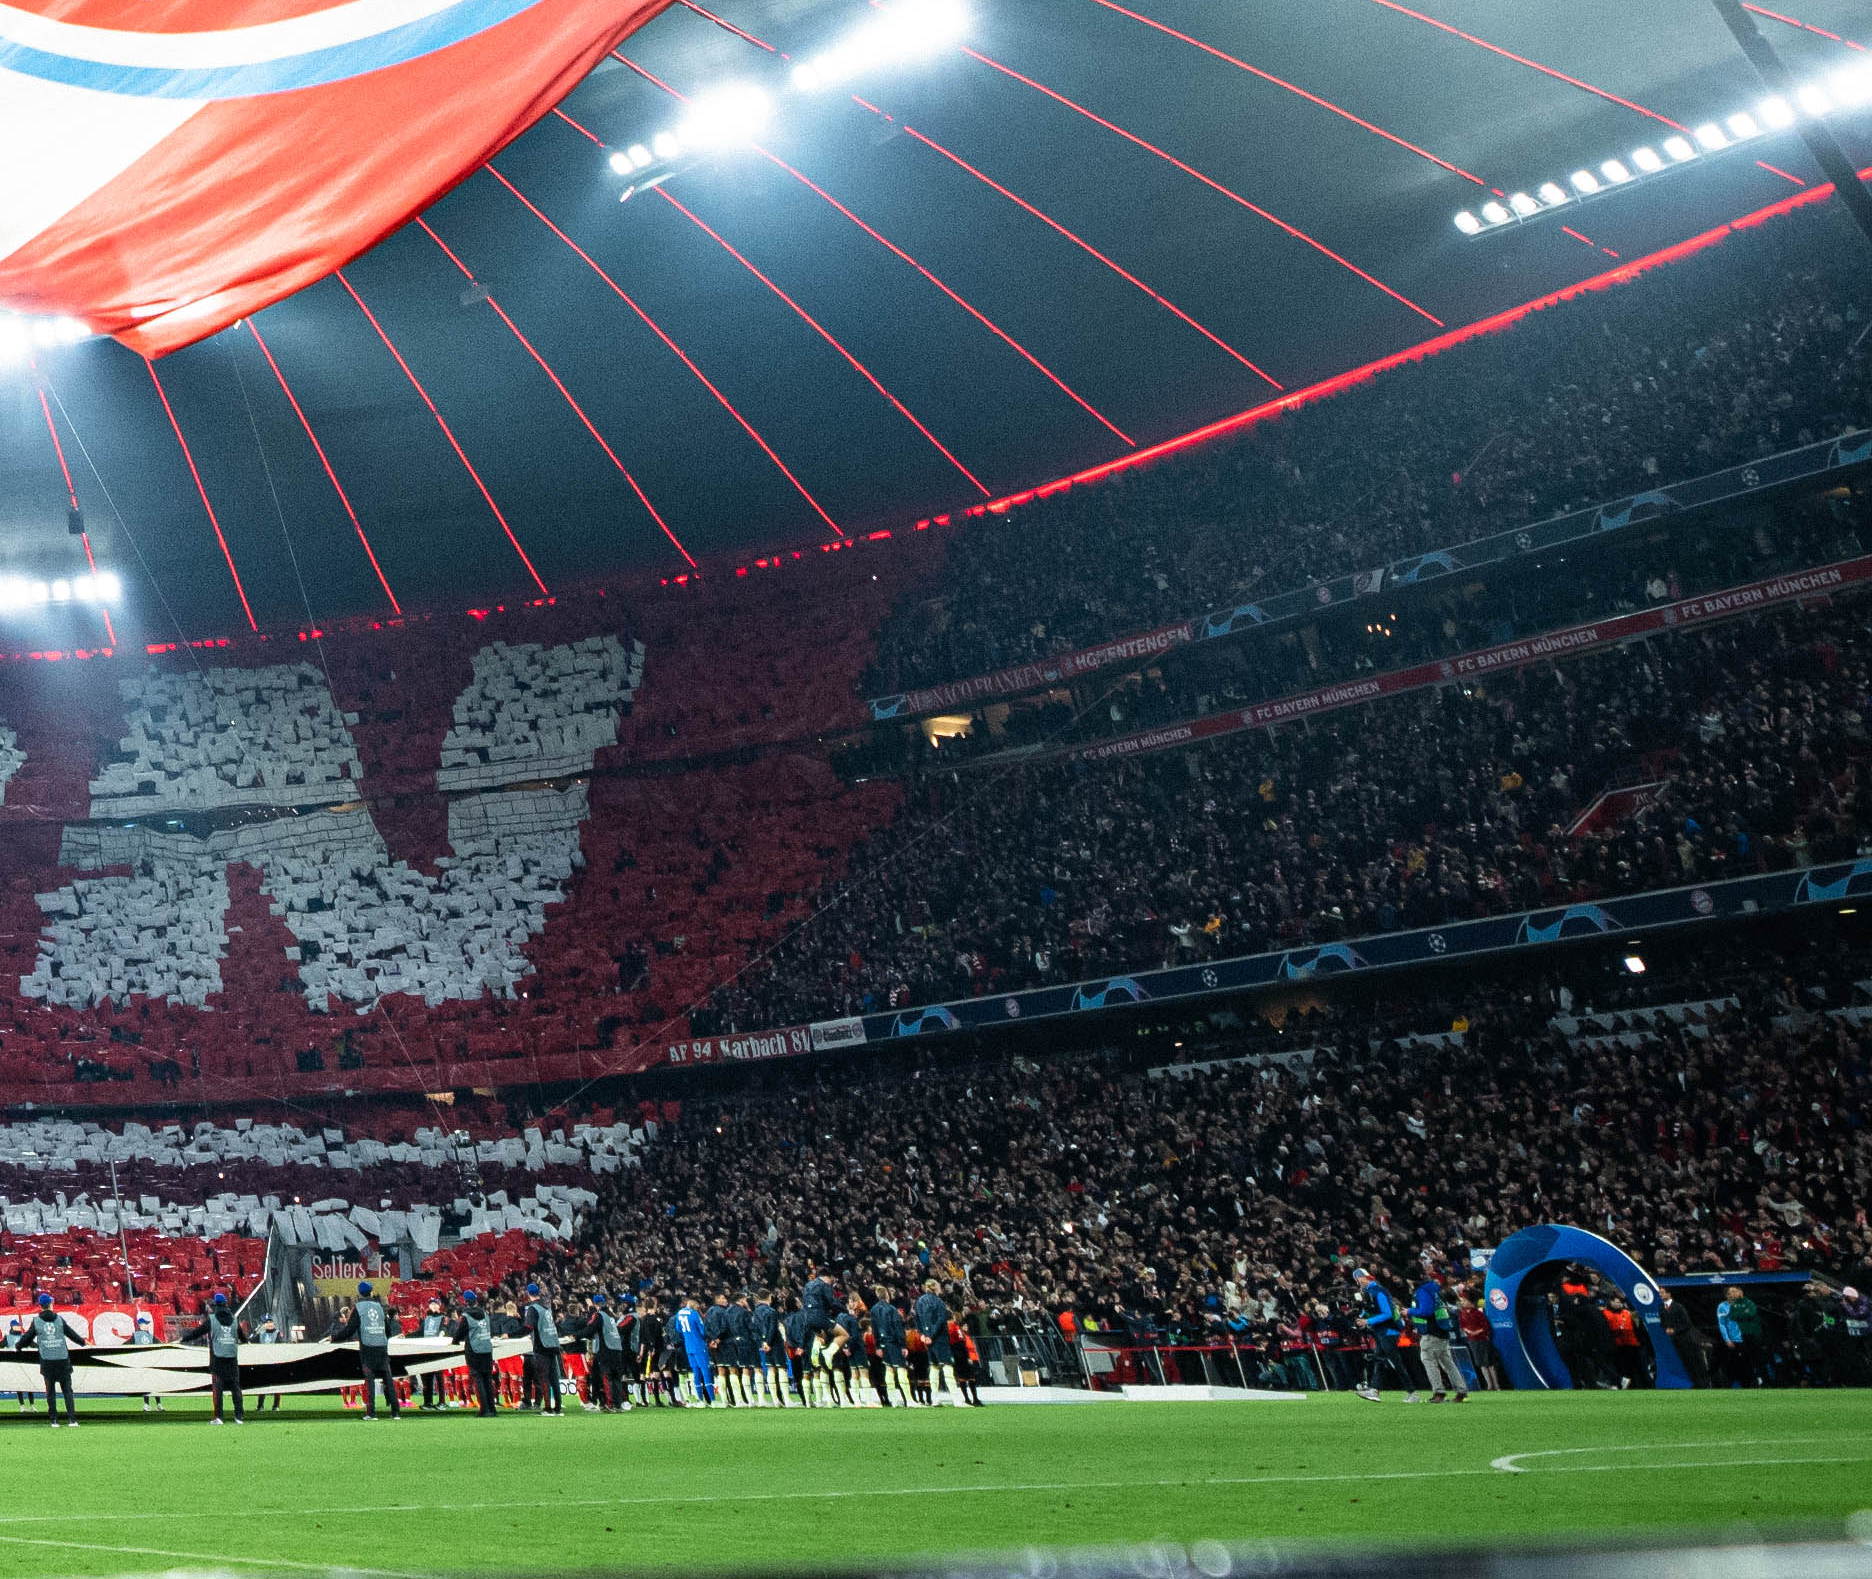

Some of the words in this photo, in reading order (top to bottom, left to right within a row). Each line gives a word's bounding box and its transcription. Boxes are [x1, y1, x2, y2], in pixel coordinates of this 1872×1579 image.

[1682, 603, 1701, 619] FC
[1705, 587, 1763, 614] BAYERN
[1767, 568, 1841, 598] MÜNCHEN
[1457, 658, 1474, 673] FC
[1477, 644, 1529, 668] BAYERN
[1532, 628, 1598, 656] MÜNCHEN
[1256, 707, 1273, 721] FC
[1274, 696, 1320, 718] BAYERN
[1321, 681, 1380, 706] MÜNCHEN
[1098, 738, 1138, 758] BAYERN
[1141, 726, 1192, 749] MÜNCHEN
[693, 1041, 712, 1059] 94
[720, 1033, 787, 1059] Karbach
[312, 1254, 366, 1279] Selters
